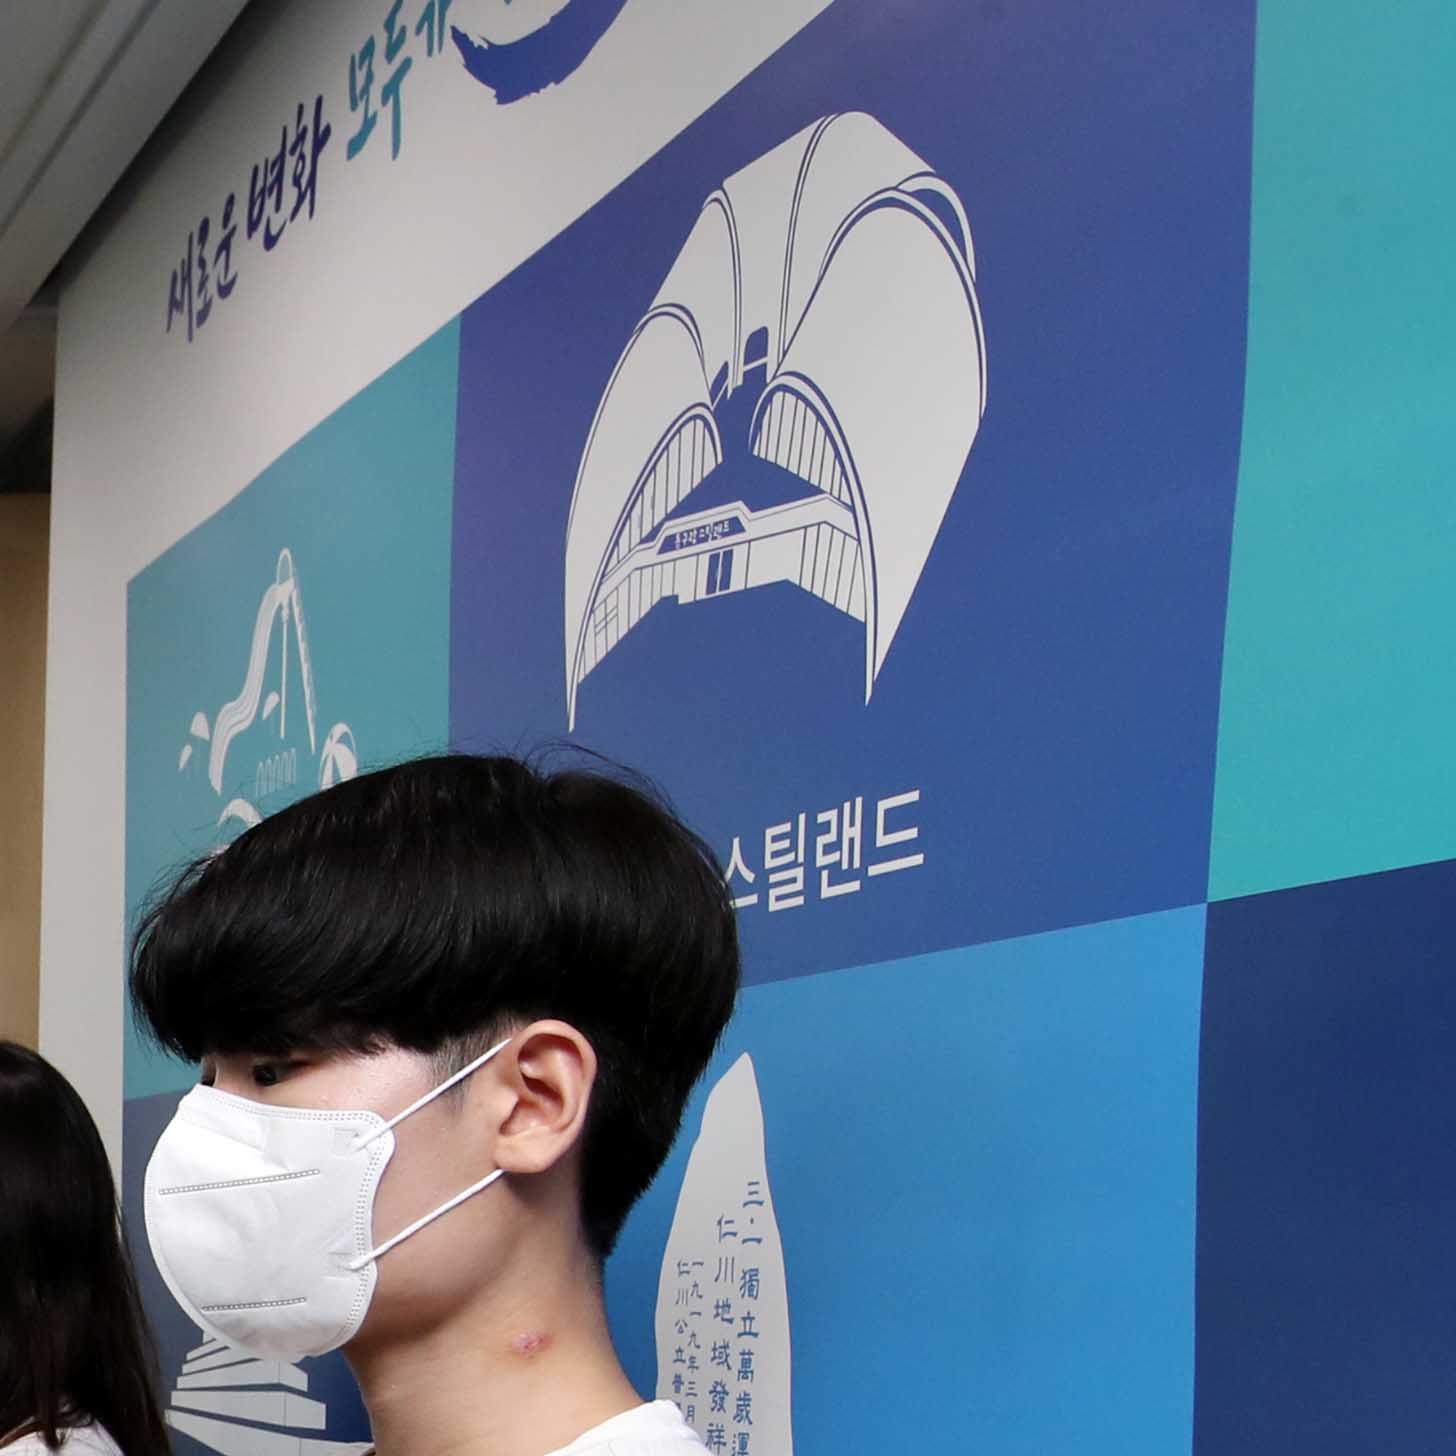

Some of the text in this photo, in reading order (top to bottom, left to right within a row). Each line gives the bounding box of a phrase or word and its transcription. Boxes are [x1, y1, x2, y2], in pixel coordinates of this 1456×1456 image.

[166, 192, 238, 343] 새로운
[246, 94, 332, 252] 변화
[724, 789, 925, 912] 스틸랜드
